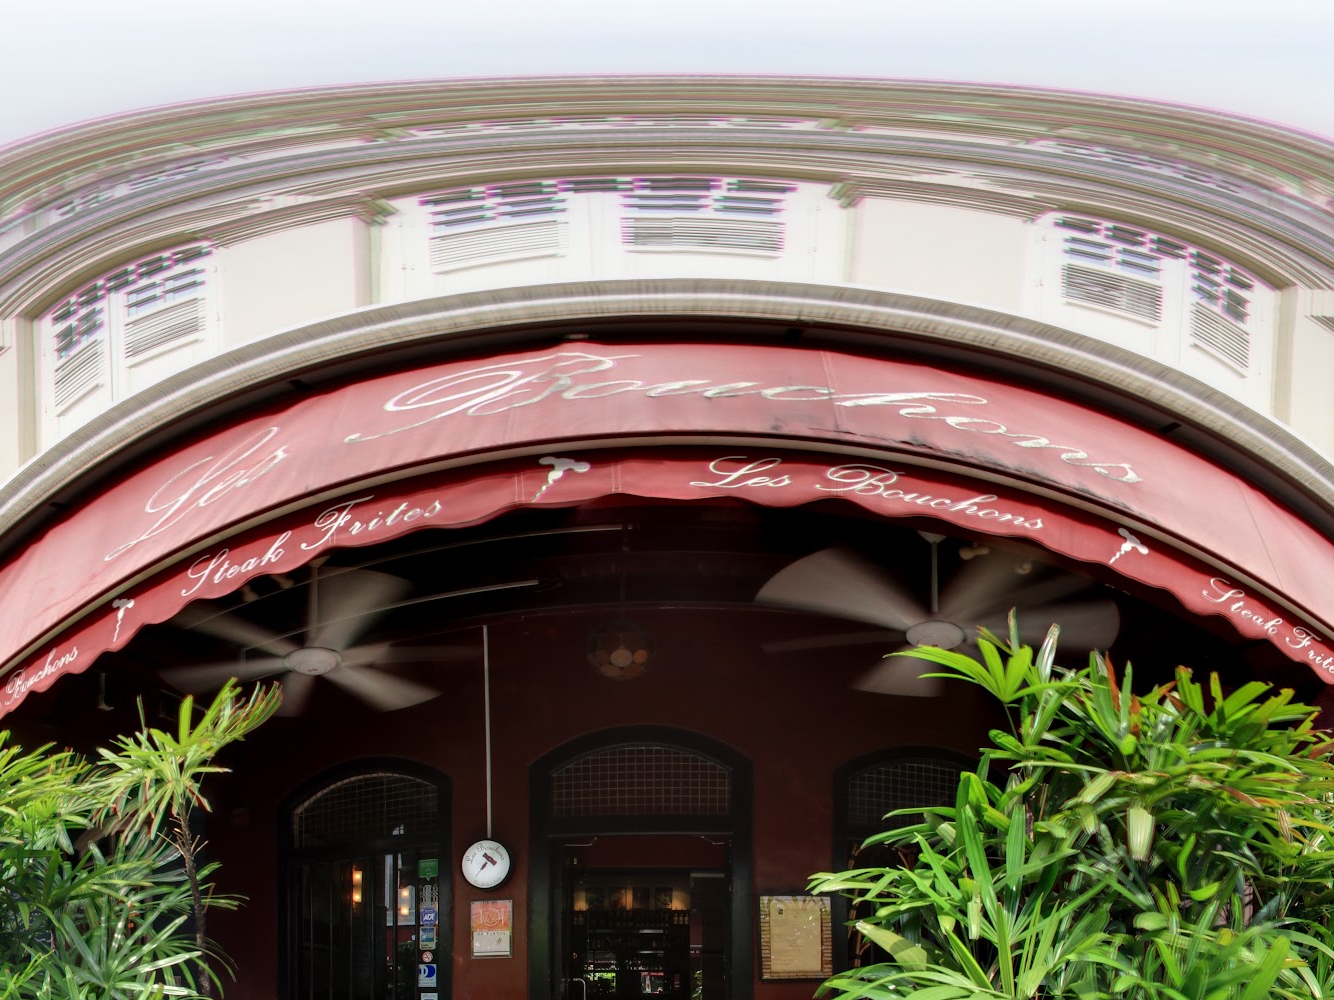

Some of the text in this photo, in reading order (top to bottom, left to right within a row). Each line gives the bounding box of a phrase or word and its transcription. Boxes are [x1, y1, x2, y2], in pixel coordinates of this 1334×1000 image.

[104, 351, 1144, 561] Les Bouchons
[690, 456, 1044, 530] Les Bouchons
[181, 495, 443, 597] Steak Frites
[1202, 577, 1283, 635] Steak
[5, 646, 79, 705] Bouchons
[423, 913, 435, 921] ADT
